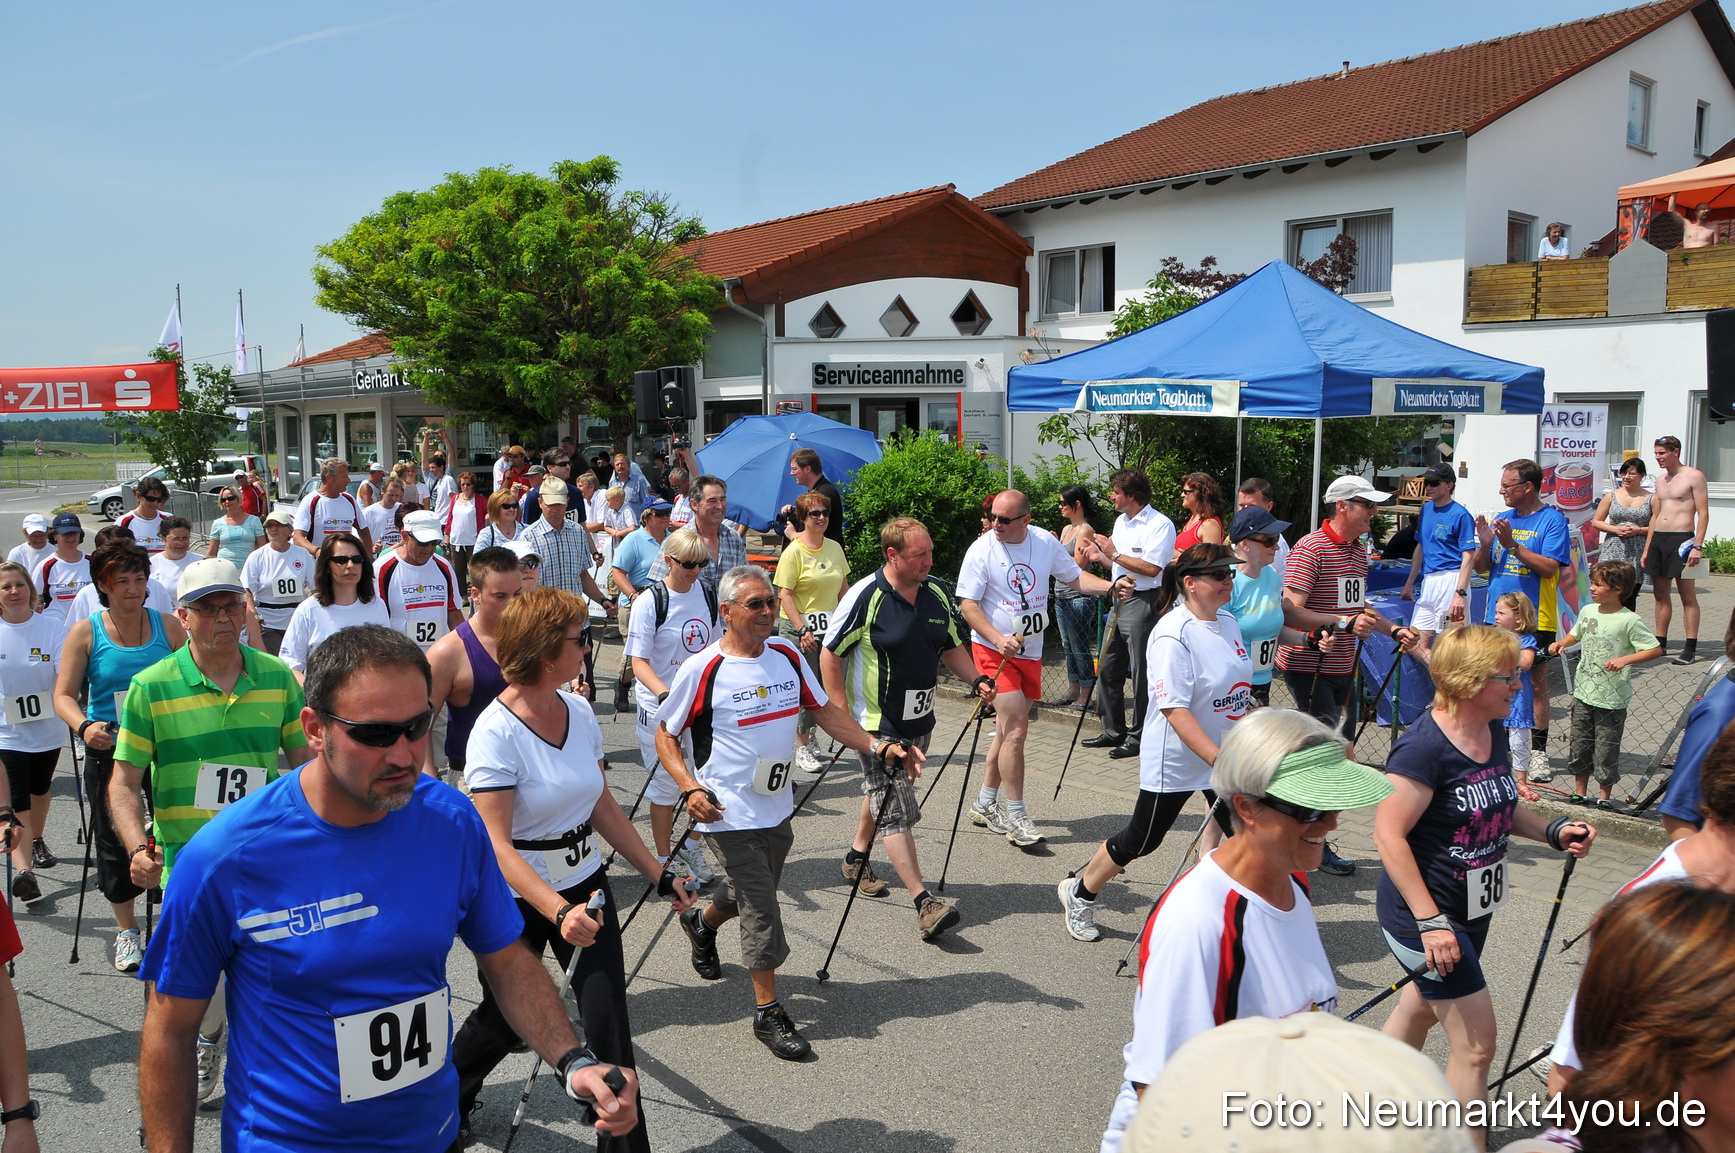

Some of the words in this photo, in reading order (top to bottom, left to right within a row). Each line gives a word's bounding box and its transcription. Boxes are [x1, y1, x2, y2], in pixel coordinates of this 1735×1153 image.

[355, 369, 399, 390] Gerhart
[813, 363, 964, 386] Serviceannahme
[0, 381, 102, 410] +ZIEL
[1092, 388, 1156, 406] Neumarkter
[1156, 388, 1207, 408] Tagblatt
[1400, 389, 1449, 407] Neumarkter
[1448, 390, 1480, 409] Tagblatt
[1561, 449, 1597, 458] Yourself
[278, 579, 297, 595] 80
[1345, 579, 1360, 604] 88
[416, 622, 437, 643] 52
[808, 613, 829, 632] 36
[1022, 612, 1043, 637] 20
[1260, 639, 1276, 666] 87
[16, 694, 42, 719] 10
[913, 688, 935, 715] 39
[1213, 690, 1246, 708] GERHART
[216, 767, 248, 804] 13
[767, 761, 792, 792] 61
[1455, 780, 1502, 812] SOUTH
[1480, 863, 1504, 910] 38
[369, 1002, 432, 1082] 94
